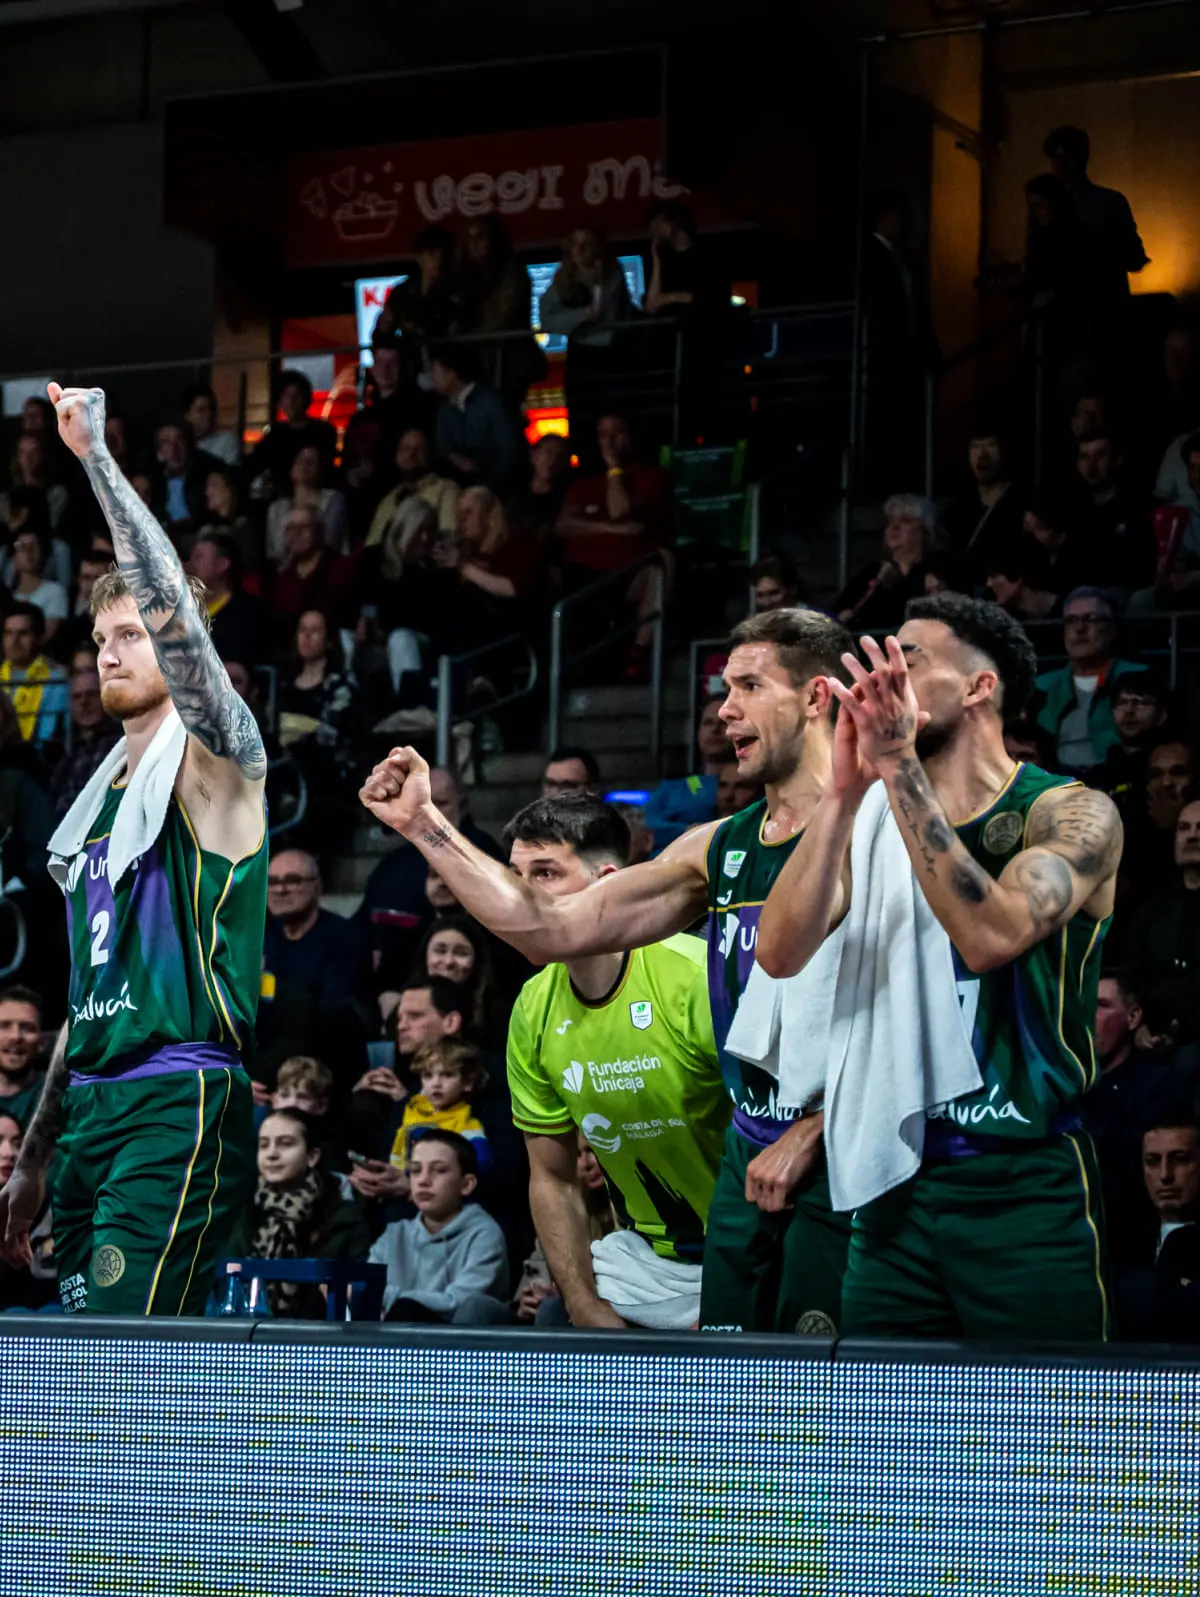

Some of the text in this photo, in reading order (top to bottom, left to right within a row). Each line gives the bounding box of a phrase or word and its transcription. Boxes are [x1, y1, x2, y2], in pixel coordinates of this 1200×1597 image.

[90, 910, 110, 967] 2
[587, 1053, 662, 1077] Fundación
[591, 1073, 645, 1094] Unicaja
[60, 1273, 85, 1293] OSTA
